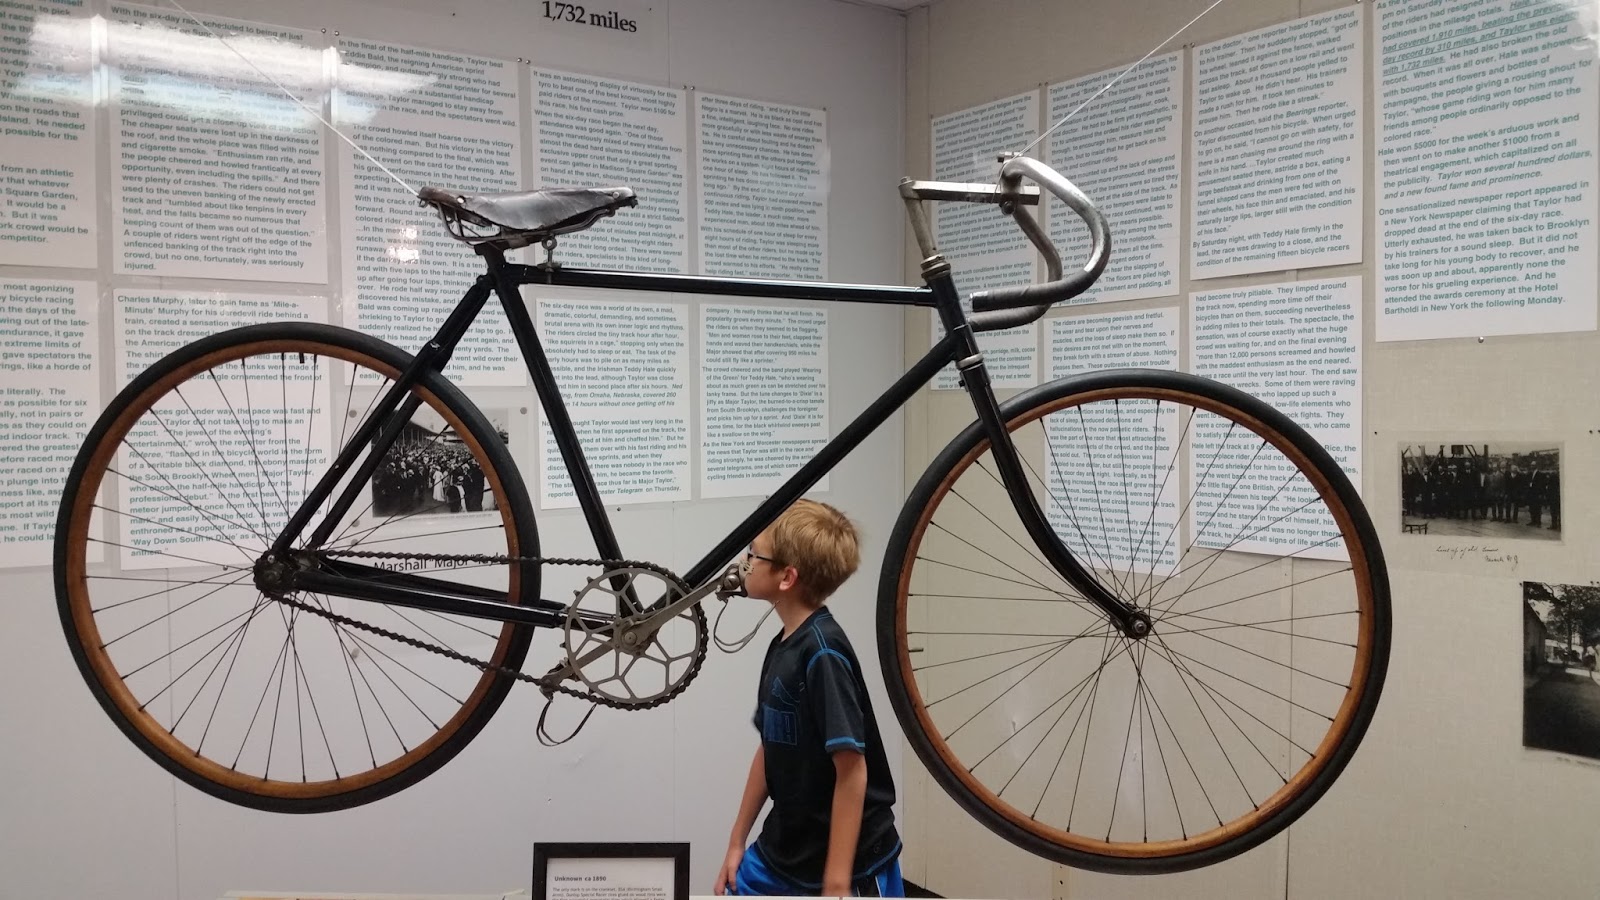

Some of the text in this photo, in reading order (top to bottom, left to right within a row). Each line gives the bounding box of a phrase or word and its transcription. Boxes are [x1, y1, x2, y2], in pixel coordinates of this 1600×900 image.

[542, 0, 637, 32] 1,732 miles
[361, 42, 377, 50] final
[400, 48, 430, 58] half-mile
[467, 57, 488, 66] Taylor
[1378, 148, 1394, 156] Hale
[1414, 139, 1436, 150] $5000
[1498, 123, 1534, 135] arduous
[1536, 117, 1559, 128] work
[1562, 113, 1580, 124] and
[1384, 131, 1412, 142] colored
[1396, 199, 1456, 213] sensationalized
[1458, 194, 1503, 205] newspaper
[1505, 188, 1532, 199] report
[1534, 182, 1577, 195] appeared
[1409, 214, 1427, 222] York
[1428, 209, 1474, 220] Newspaper
[1475, 204, 1511, 214] claiming
[1514, 201, 1530, 210] that
[1533, 197, 1562, 207] Taylor
[1564, 193, 1582, 203] had
[1384, 227, 1416, 237] dropped
[1418, 224, 1437, 233] dead
[1463, 219, 1478, 228] end
[1480, 217, 1489, 226] of
[1507, 213, 1539, 222] six-day
[222, 235, 240, 244] right
[269, 238, 288, 247] edge
[124, 262, 156, 270] injured.
[30, 285, 74, 294] agonizing
[1295, 284, 1319, 293] limped
[1320, 281, 1346, 290] around
[1384, 294, 1417, 303] attended
[1433, 291, 1462, 300] awards
[1464, 289, 1506, 298] ceremony
[1534, 283, 1558, 292] Hotel
[9, 294, 74, 306] bicycle racing
[118, 295, 150, 303] Charles
[1384, 306, 1419, 315] Bartholdi
[1450, 302, 1468, 310] York
[1486, 299, 1525, 307] following
[1528, 296, 1565, 304] Monday.
[1112, 315, 1133, 323] peevish
[1318, 336, 1347, 344] evening
[374, 559, 426, 572] Marshall
